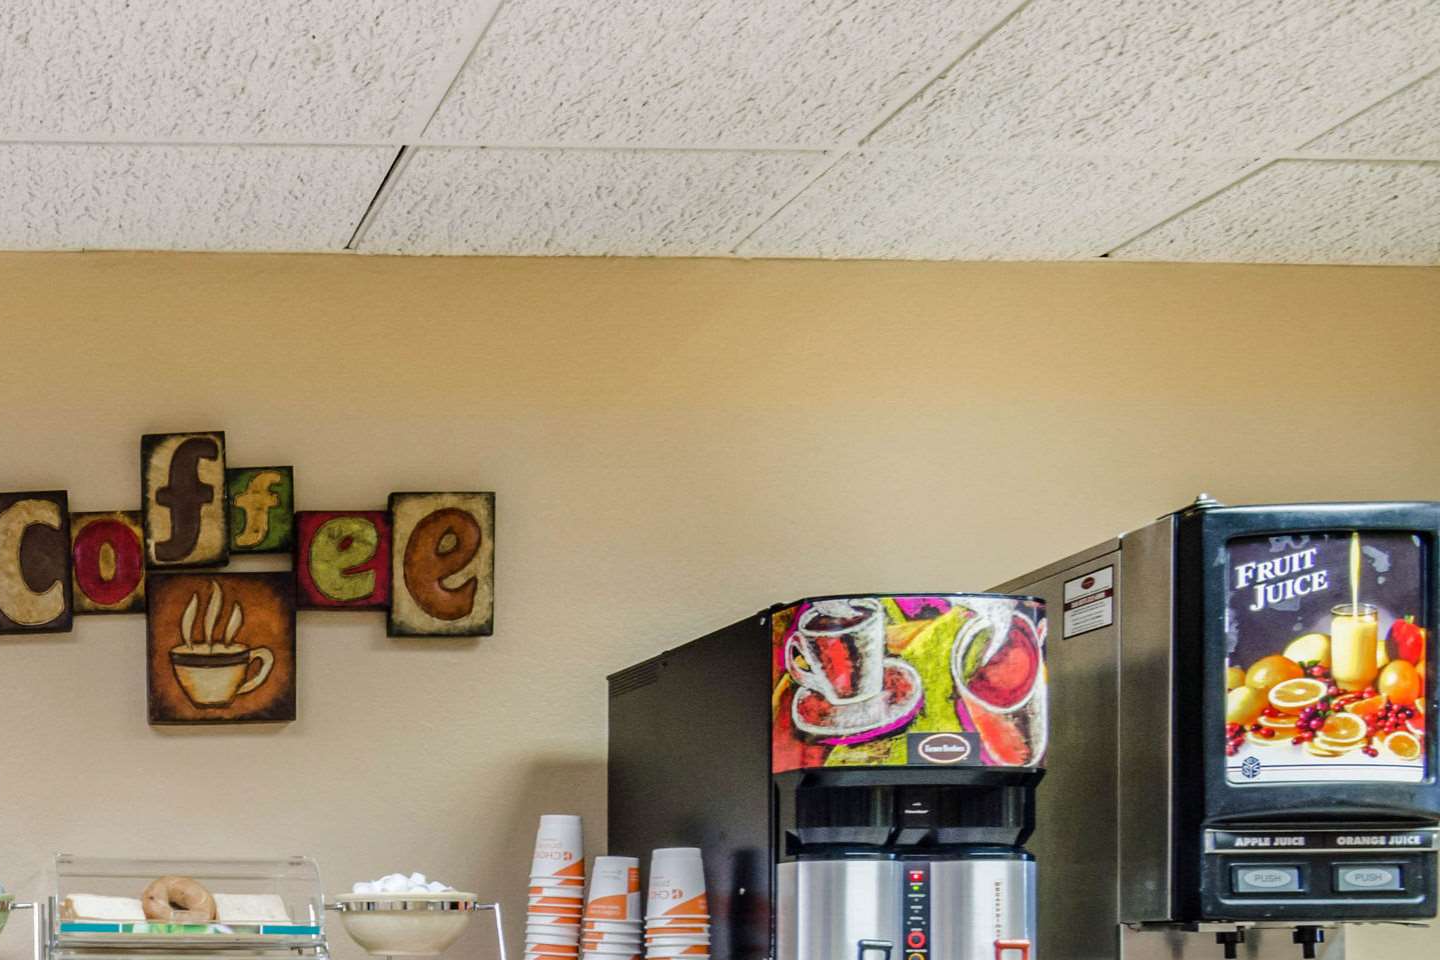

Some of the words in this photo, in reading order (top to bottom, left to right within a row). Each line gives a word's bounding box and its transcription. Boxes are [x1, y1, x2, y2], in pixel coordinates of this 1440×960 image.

[1234, 548, 1317, 589] FRUIT
[1249, 570, 1329, 611] JUICE
[1234, 836, 1270, 847] APPLE
[1273, 836, 1306, 847] JUICE
[1336, 835, 1385, 846] ORANGE
[1388, 835, 1422, 846] JUICE
[1253, 873, 1281, 882] PUSH
[1354, 873, 1383, 882] PUSH
